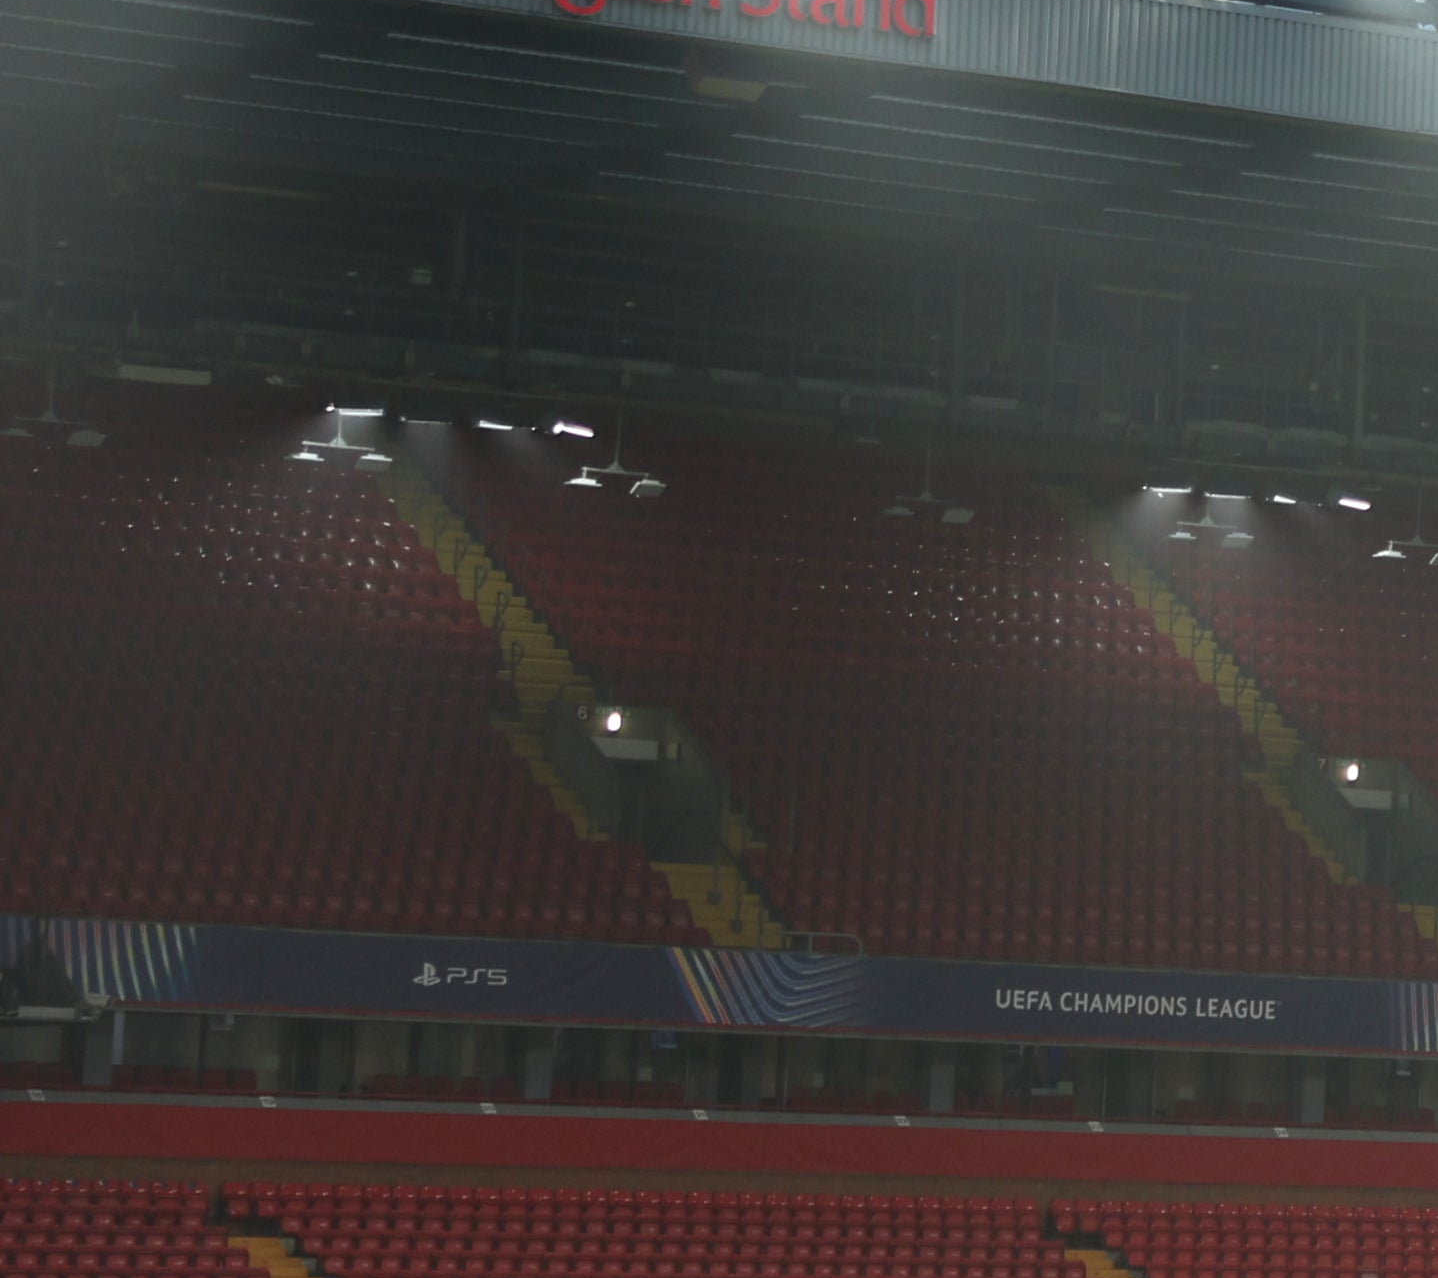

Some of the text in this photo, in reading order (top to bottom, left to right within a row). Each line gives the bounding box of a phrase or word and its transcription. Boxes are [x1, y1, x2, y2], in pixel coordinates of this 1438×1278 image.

[447, 967, 508, 986] PS5
[995, 987, 1277, 1020] UEFA CHAMPIONS LEAGUE
